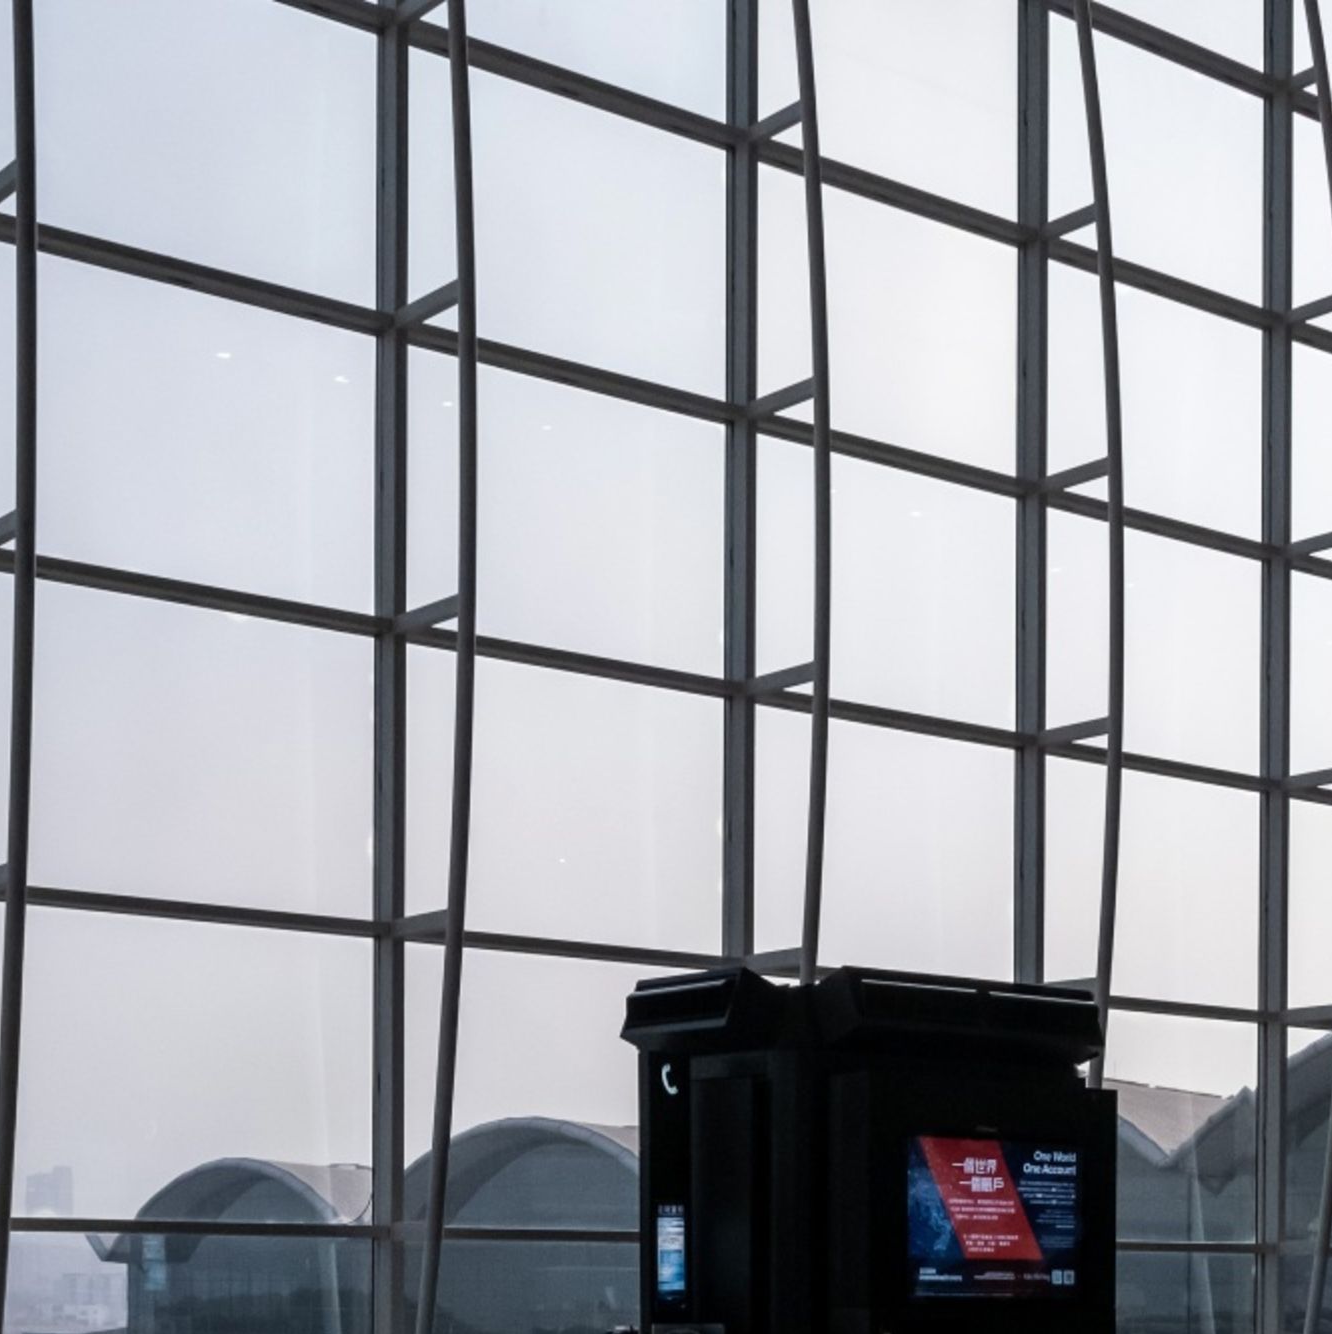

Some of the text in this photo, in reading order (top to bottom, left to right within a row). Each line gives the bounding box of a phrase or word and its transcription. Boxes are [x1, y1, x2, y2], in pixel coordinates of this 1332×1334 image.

[1033, 1150, 1077, 1162] One World
[1023, 1162, 1077, 1174] One Account
